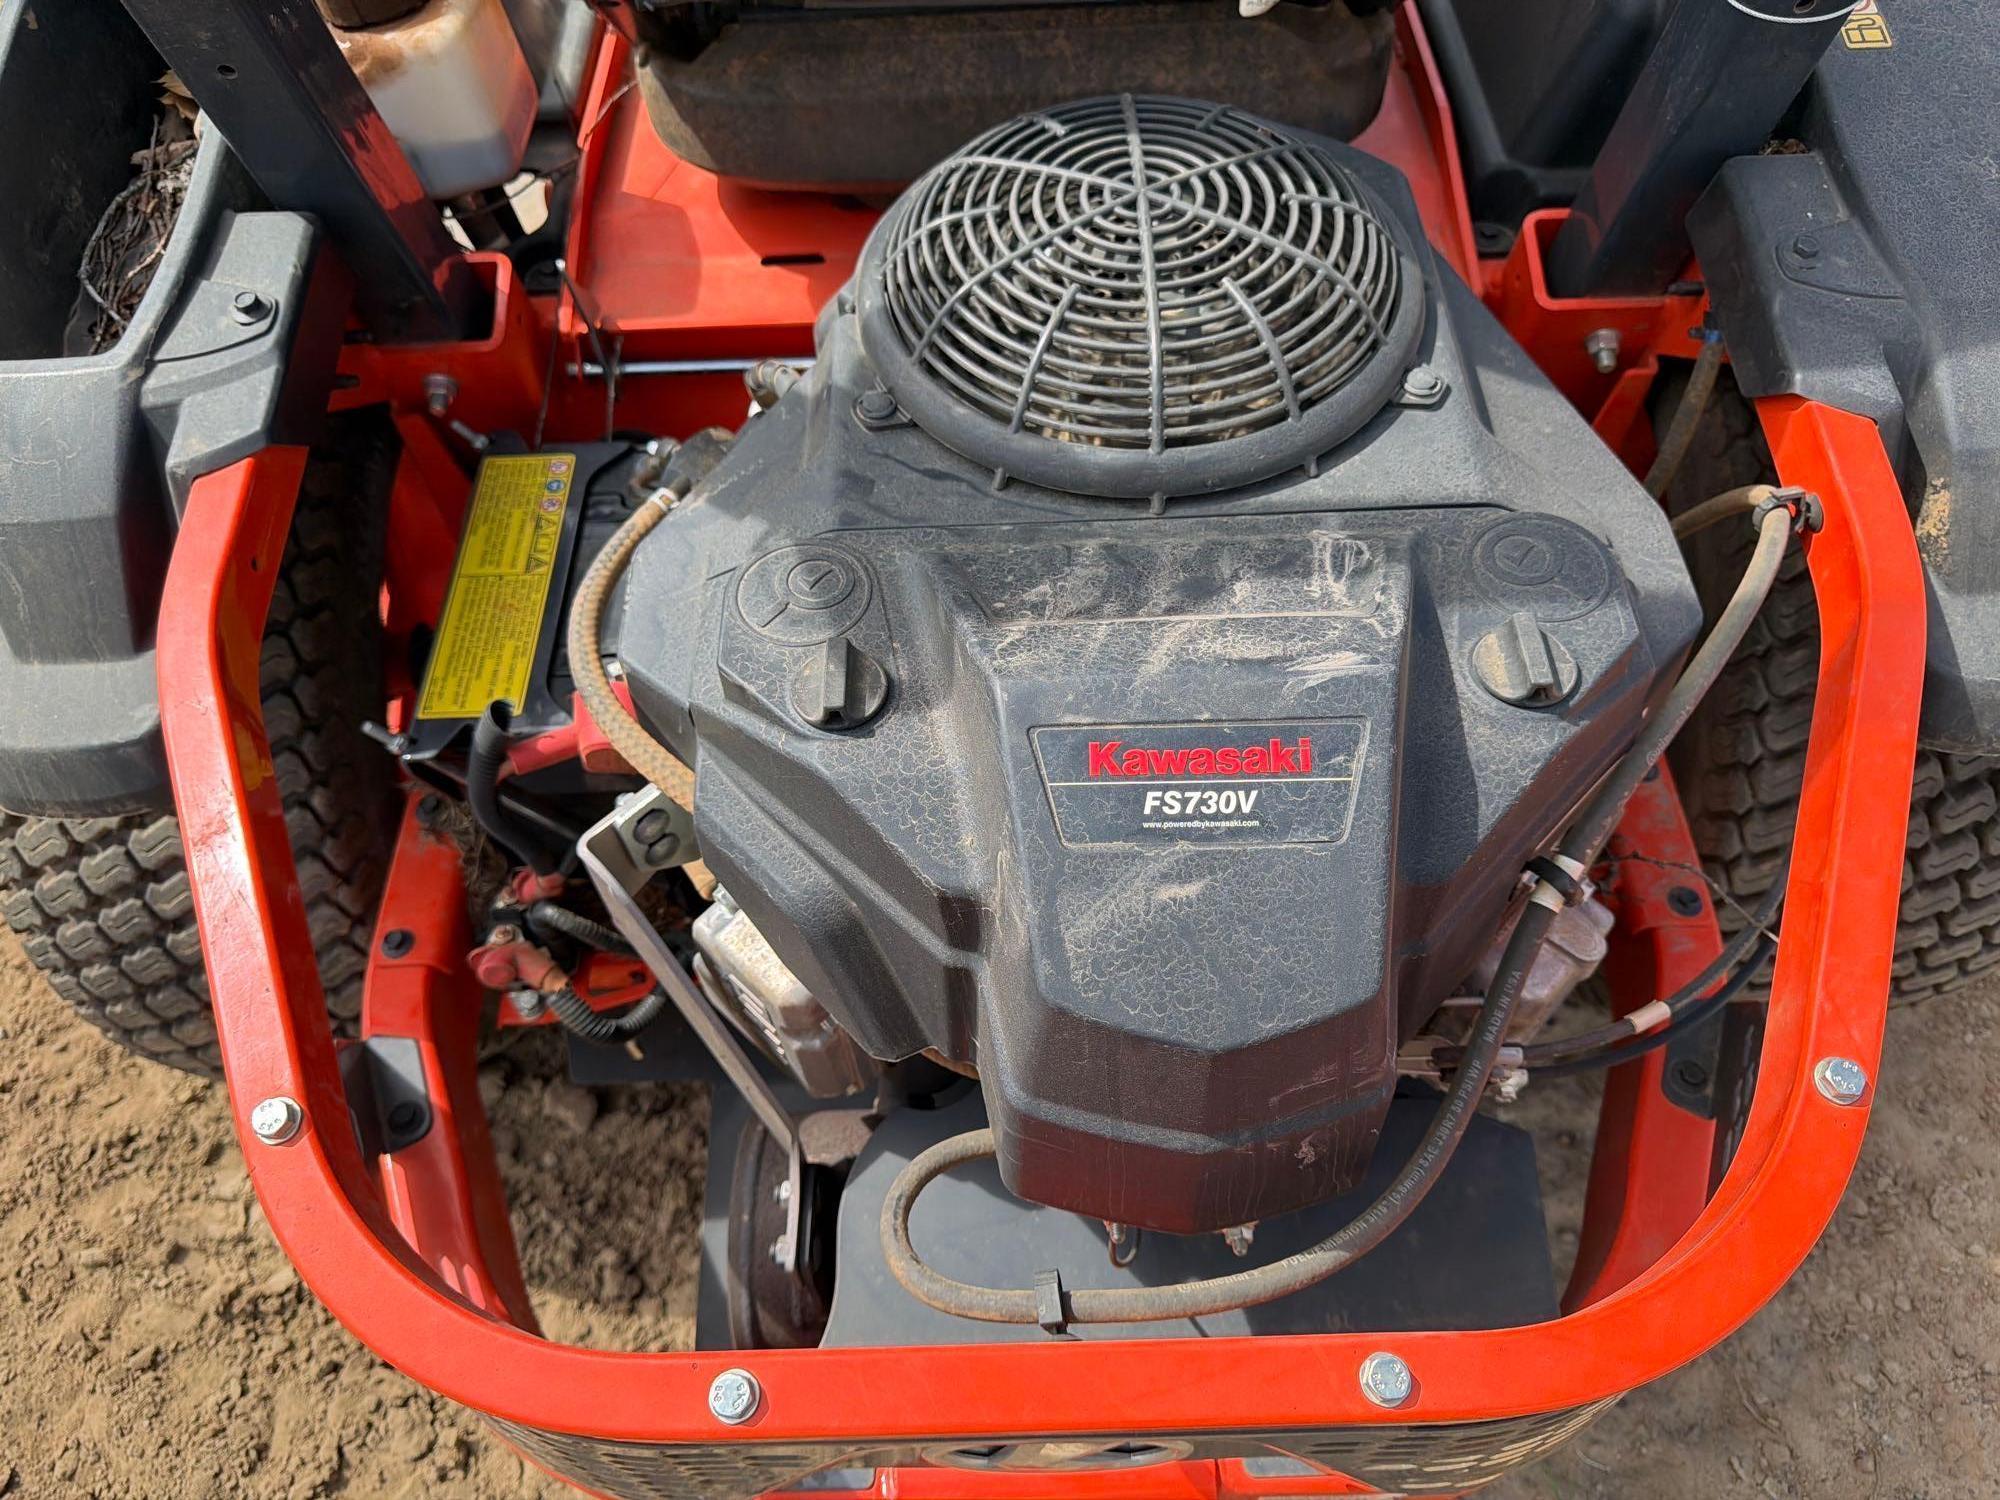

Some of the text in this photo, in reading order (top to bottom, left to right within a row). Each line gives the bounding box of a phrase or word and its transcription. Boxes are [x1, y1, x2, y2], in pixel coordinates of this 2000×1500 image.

[1088, 737, 1312, 777] Kawasaki
[1143, 790, 1259, 816] FS730V
[1142, 819, 1260, 830] www.poweredbykawasaki.com
[1457, 1078, 1474, 1101] PSI
[1468, 1058, 1483, 1080] WP
[1483, 1009, 1505, 1043] MADE
[1504, 969, 1522, 995] USA
